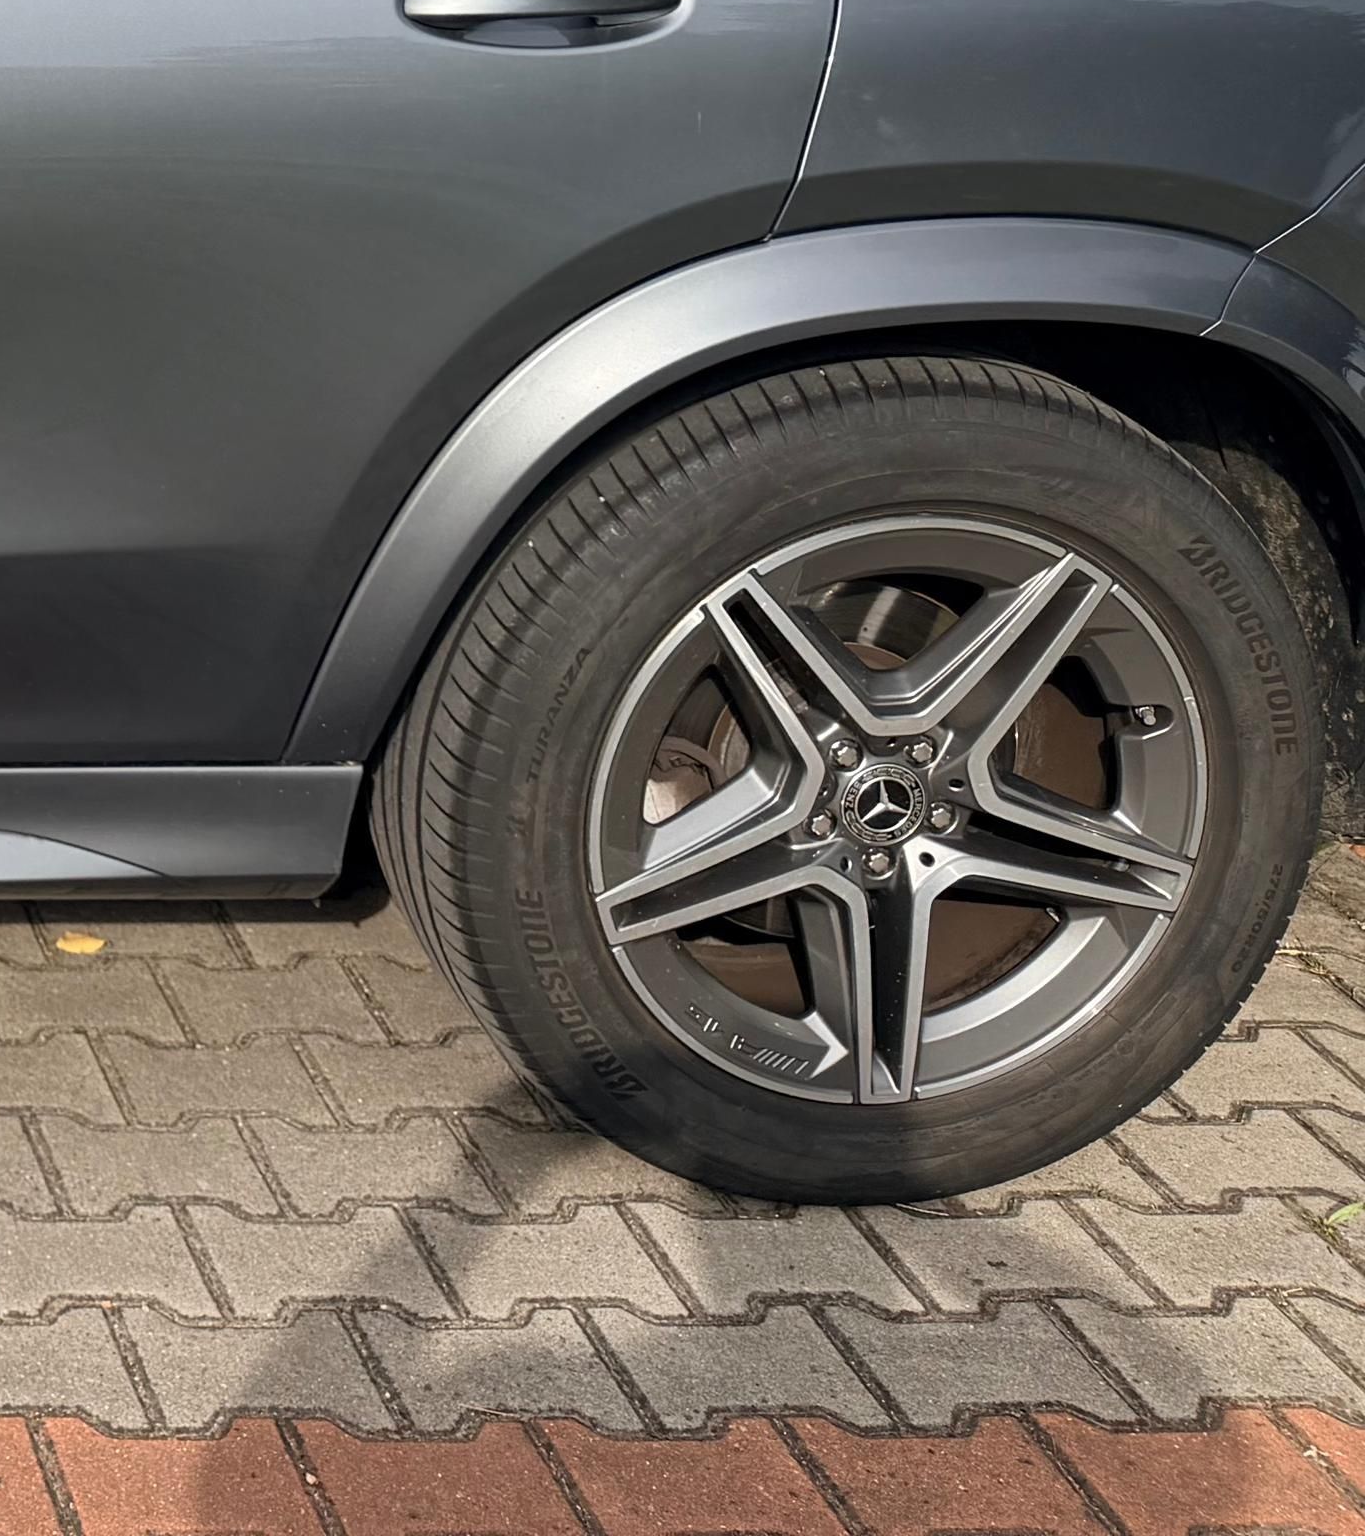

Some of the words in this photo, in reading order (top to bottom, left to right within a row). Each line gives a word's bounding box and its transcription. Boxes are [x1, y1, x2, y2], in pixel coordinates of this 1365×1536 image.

[1177, 535, 1299, 756] BRIDGESTONE
[526, 647, 591, 784] TURANZA
[845, 780, 862, 809] BENZ
[894, 788, 924, 838] MERCEDES
[515, 889, 649, 1099] BRIDGESTONE
